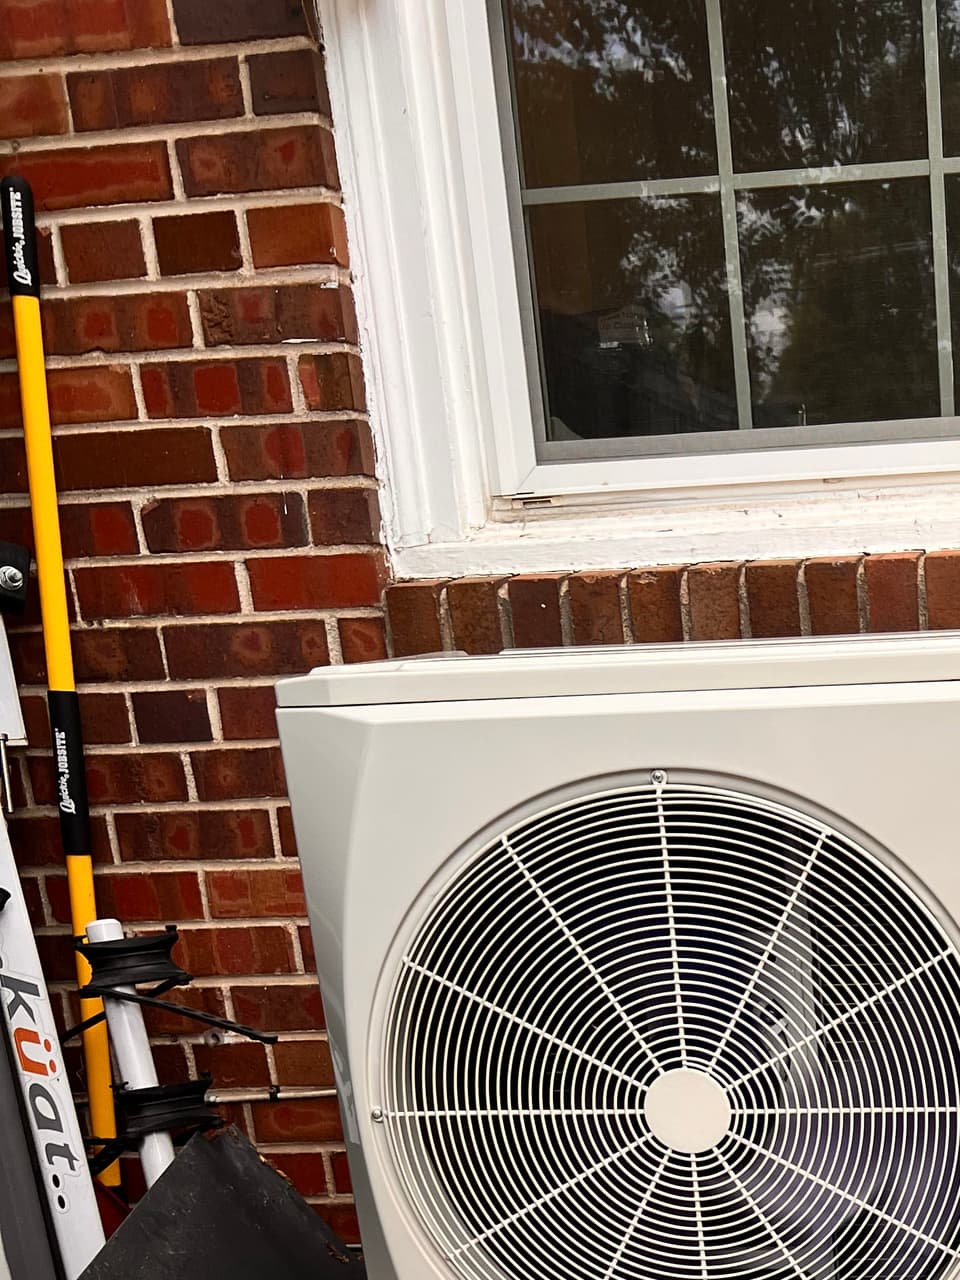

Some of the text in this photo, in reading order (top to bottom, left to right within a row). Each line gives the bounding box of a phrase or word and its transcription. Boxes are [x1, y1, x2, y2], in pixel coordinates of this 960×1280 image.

[10, 191, 32, 286] Quickie JOBSITE
[55, 731, 76, 814] Quickie JOBSITE
